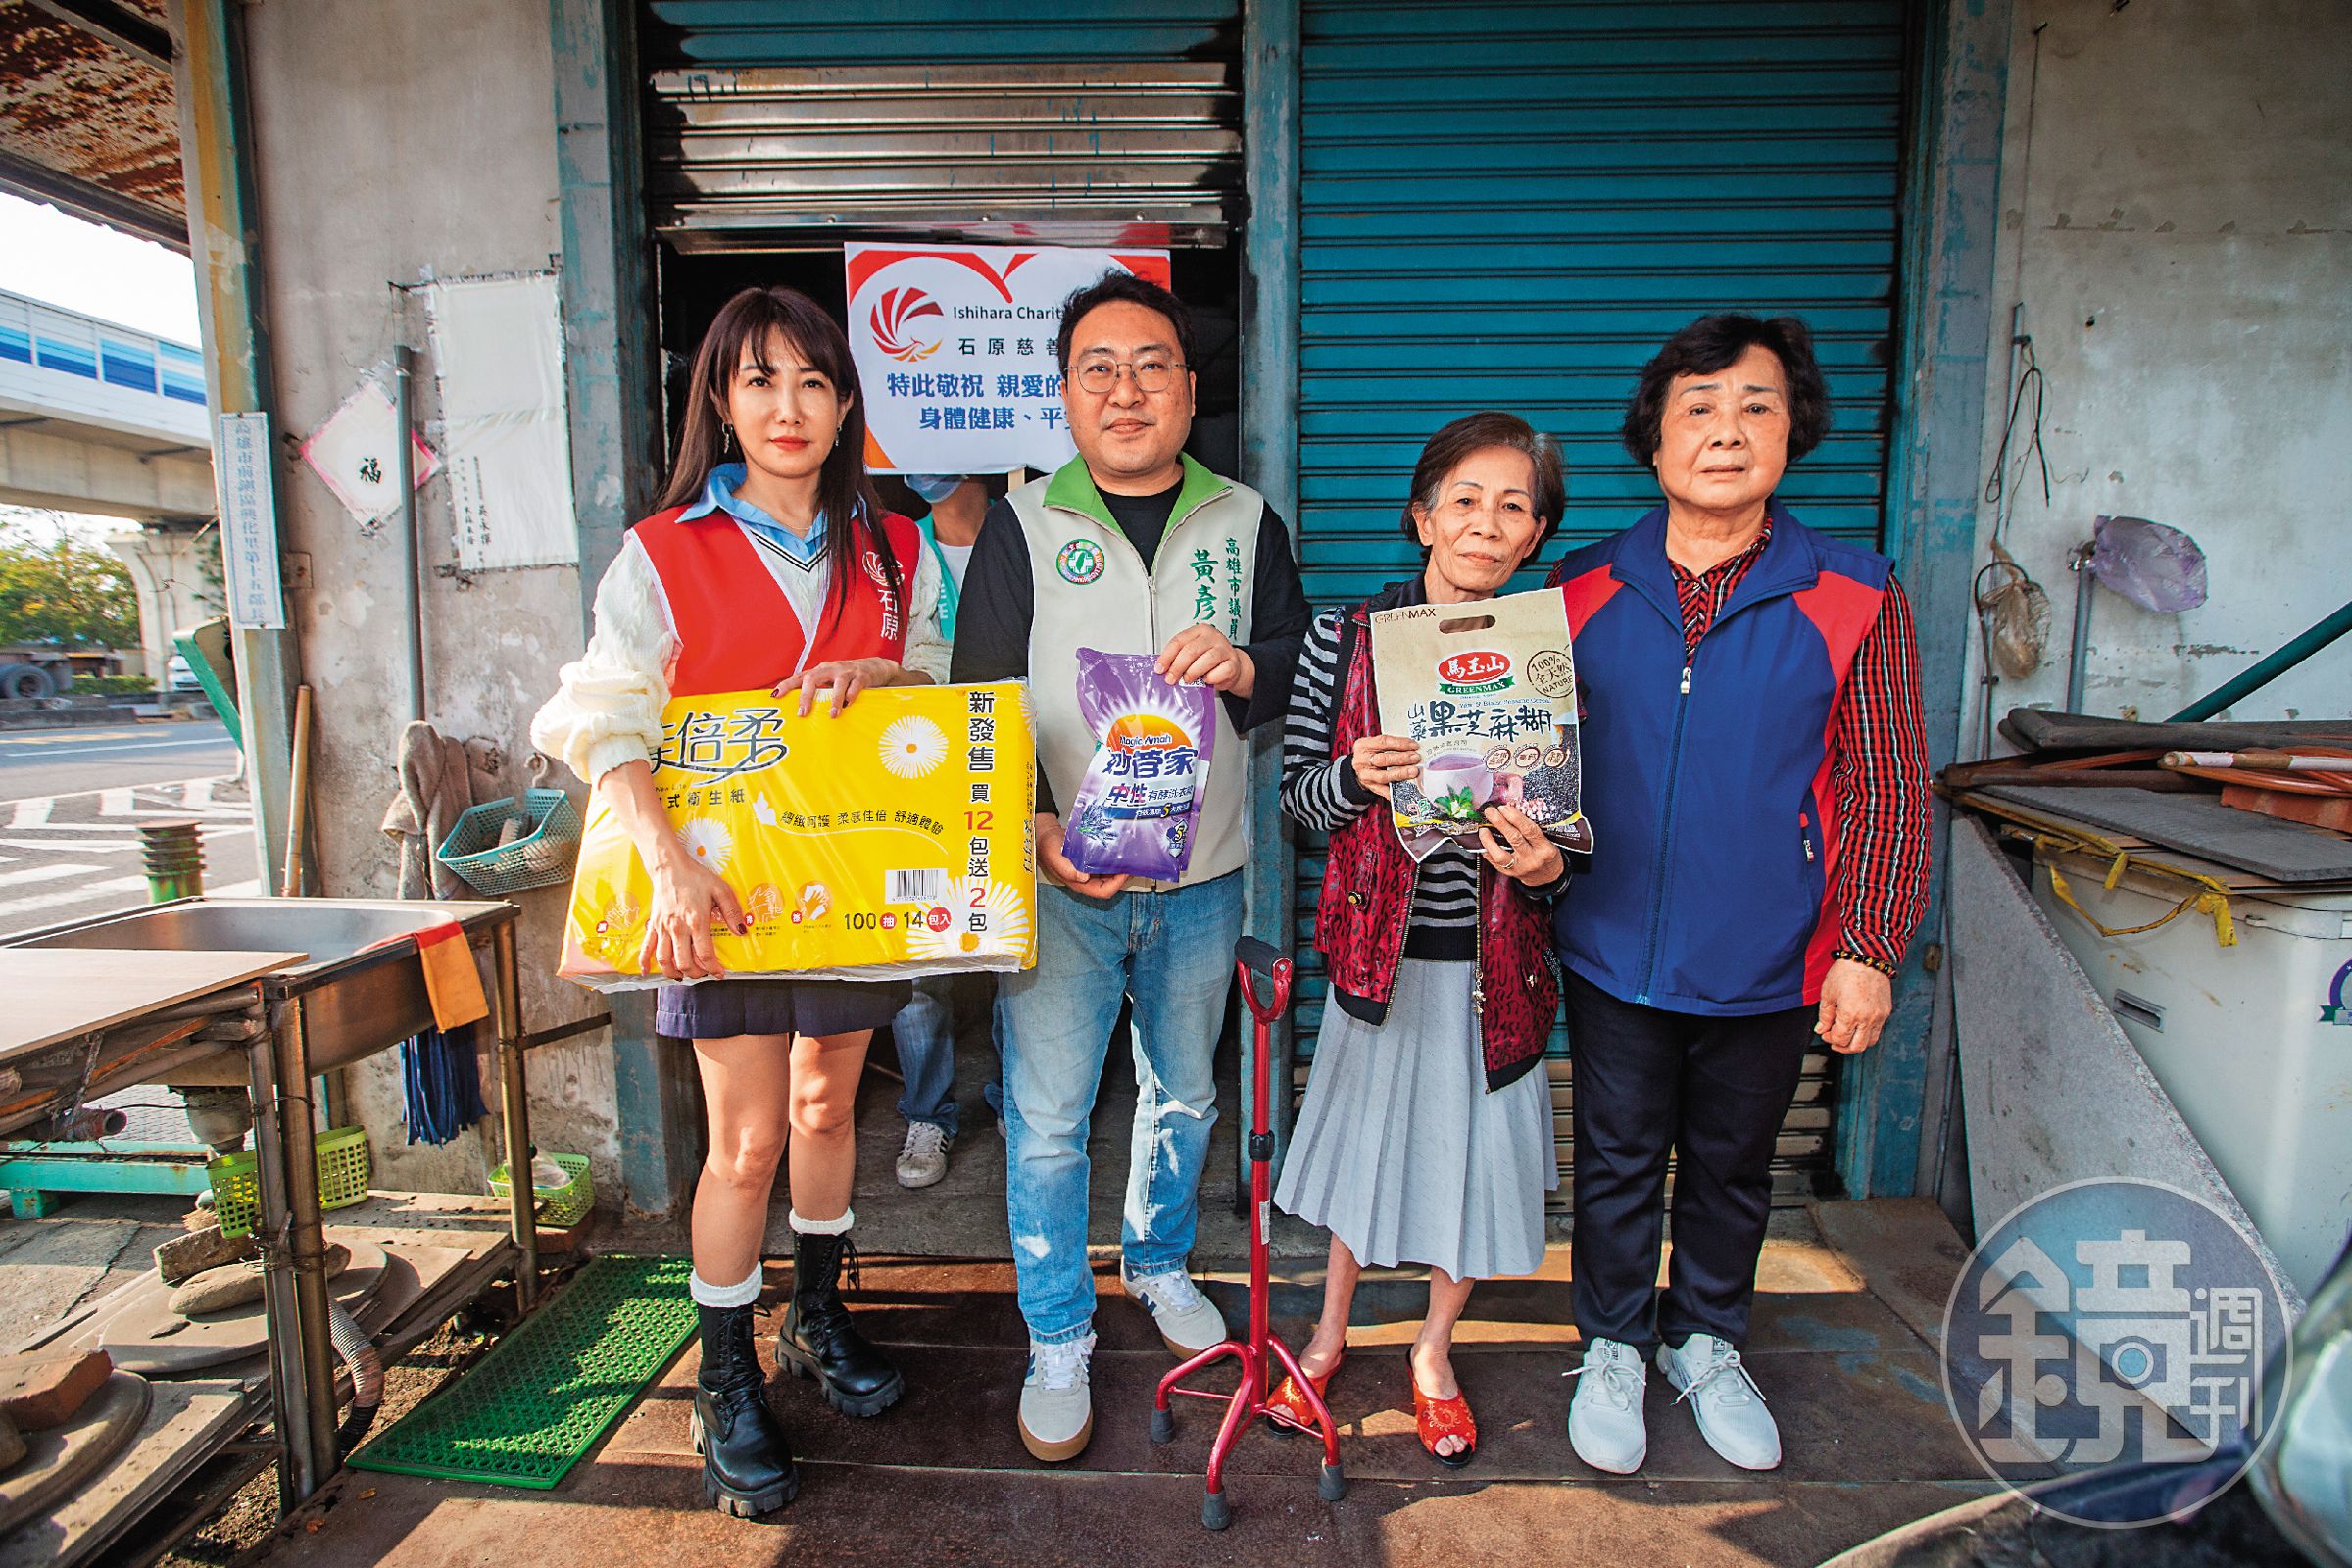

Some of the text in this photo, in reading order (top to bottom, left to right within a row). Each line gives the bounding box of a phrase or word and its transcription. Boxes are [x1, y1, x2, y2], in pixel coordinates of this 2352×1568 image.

[954, 306, 1064, 319] Ishihara Charit
[958, 337, 1059, 356] 石原慈善
[887, 372, 985, 398] 特此敬祝
[919, 406, 1072, 430] 身體健康、平
[1189, 548, 1220, 628] 黃彥
[1225, 537, 1243, 641] 高雄市議員
[877, 588, 899, 642] 石原
[1447, 655, 1506, 679] 馬玉山
[1531, 654, 1561, 673] 100%
[1446, 680, 1507, 695] GREENMAX
[1542, 674, 1574, 694] NATURE
[967, 690, 995, 772] 新發售
[1427, 700, 1553, 744] 黑芝麻糊
[1144, 733, 1172, 746] Amah
[1102, 746, 1199, 779] 妙管家
[659, 788, 746, 809] 式衛生紙
[1106, 783, 1148, 806] 中性
